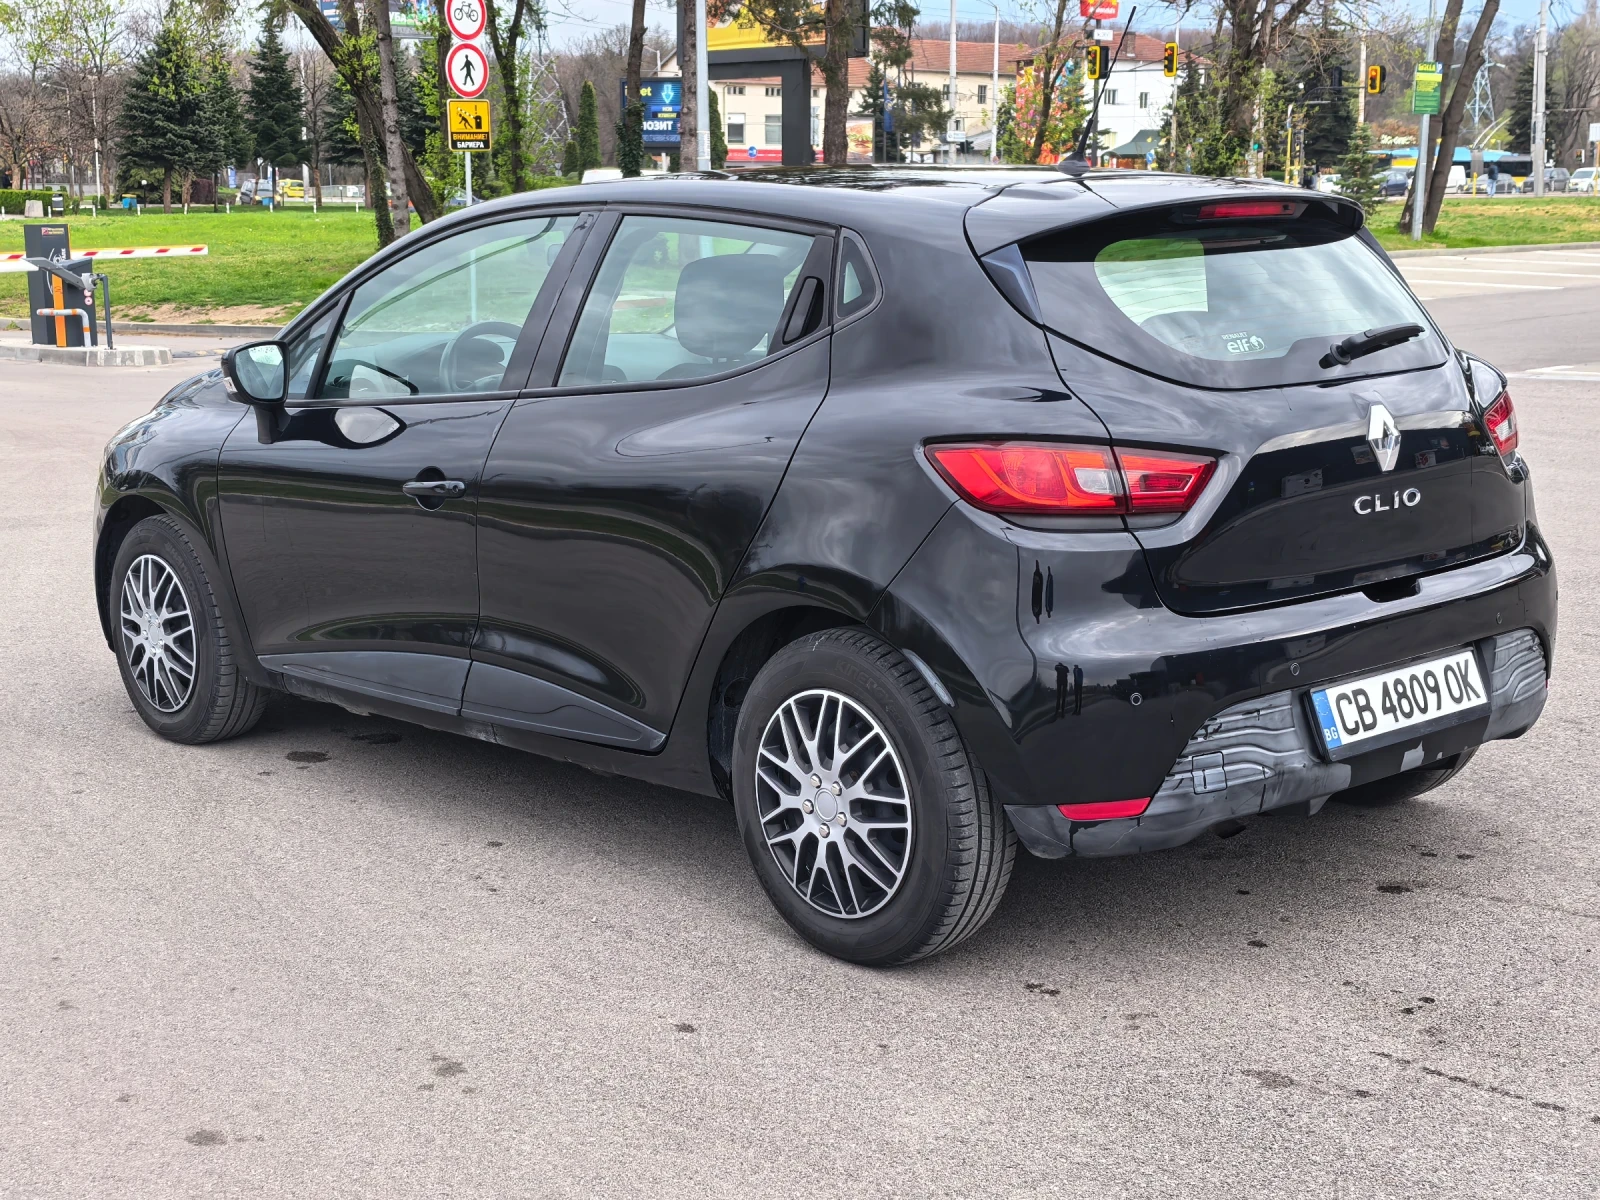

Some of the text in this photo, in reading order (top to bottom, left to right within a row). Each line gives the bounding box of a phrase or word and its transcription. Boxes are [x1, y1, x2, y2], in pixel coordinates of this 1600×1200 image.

[1221, 332, 1247, 340] RENAULT
[1227, 339, 1249, 353] elf
[1353, 487, 1421, 515] CLIO
[1335, 658, 1482, 736] CB 4809 OK
[1324, 728, 1338, 741] BG
